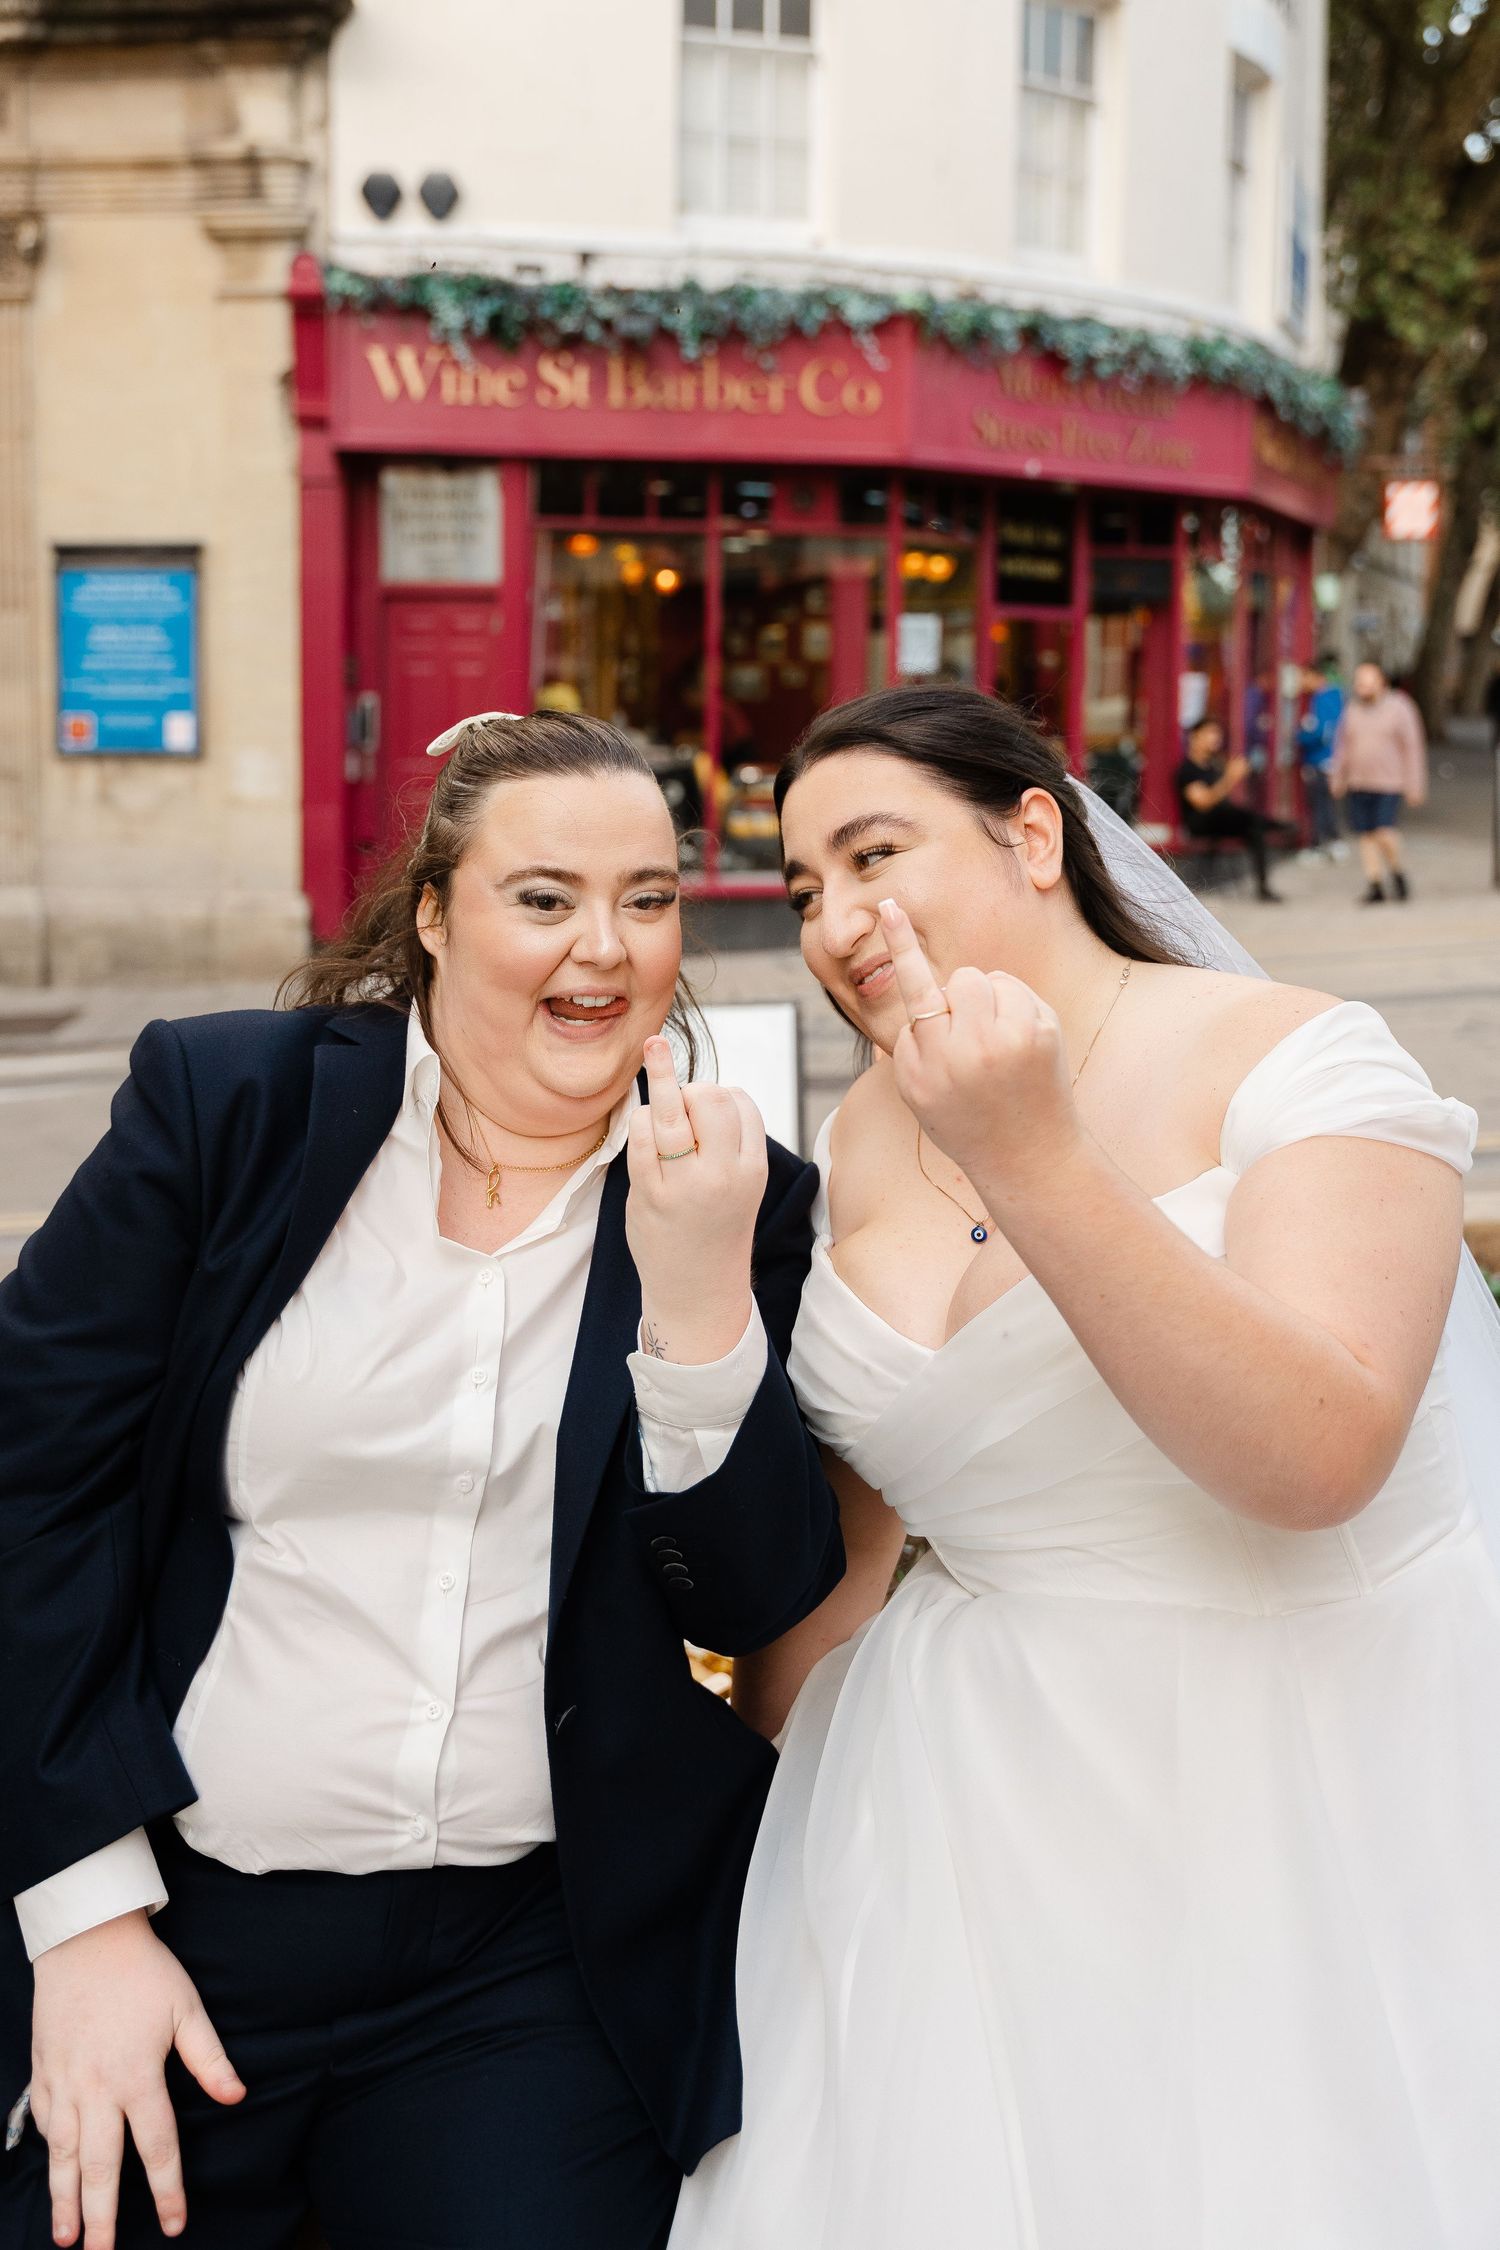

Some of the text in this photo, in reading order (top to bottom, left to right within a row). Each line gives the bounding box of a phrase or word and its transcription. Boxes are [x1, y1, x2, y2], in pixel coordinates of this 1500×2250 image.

[364, 343, 884, 417] Wine St Barber Co
